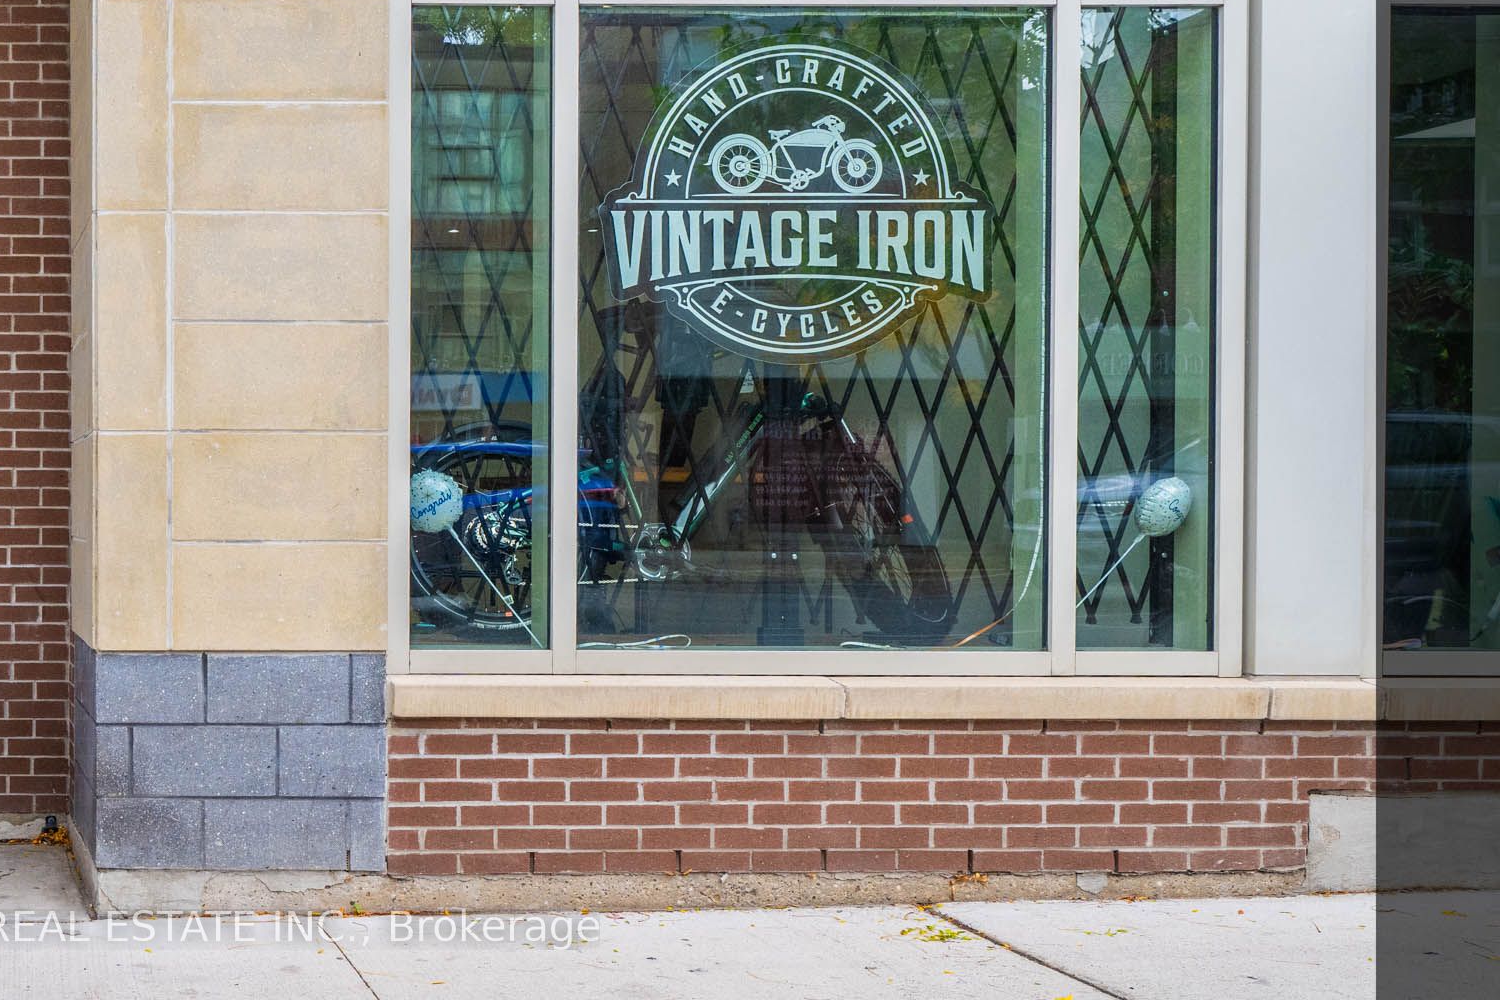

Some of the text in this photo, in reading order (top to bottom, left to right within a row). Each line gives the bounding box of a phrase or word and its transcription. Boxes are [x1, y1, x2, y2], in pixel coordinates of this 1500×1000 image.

[667, 57, 929, 160] HAND-CRAFTED
[611, 209, 987, 292] VINTAGE IRON
[710, 288, 884, 339] E-CYCLES
[411, 491, 452, 519] Congrats
